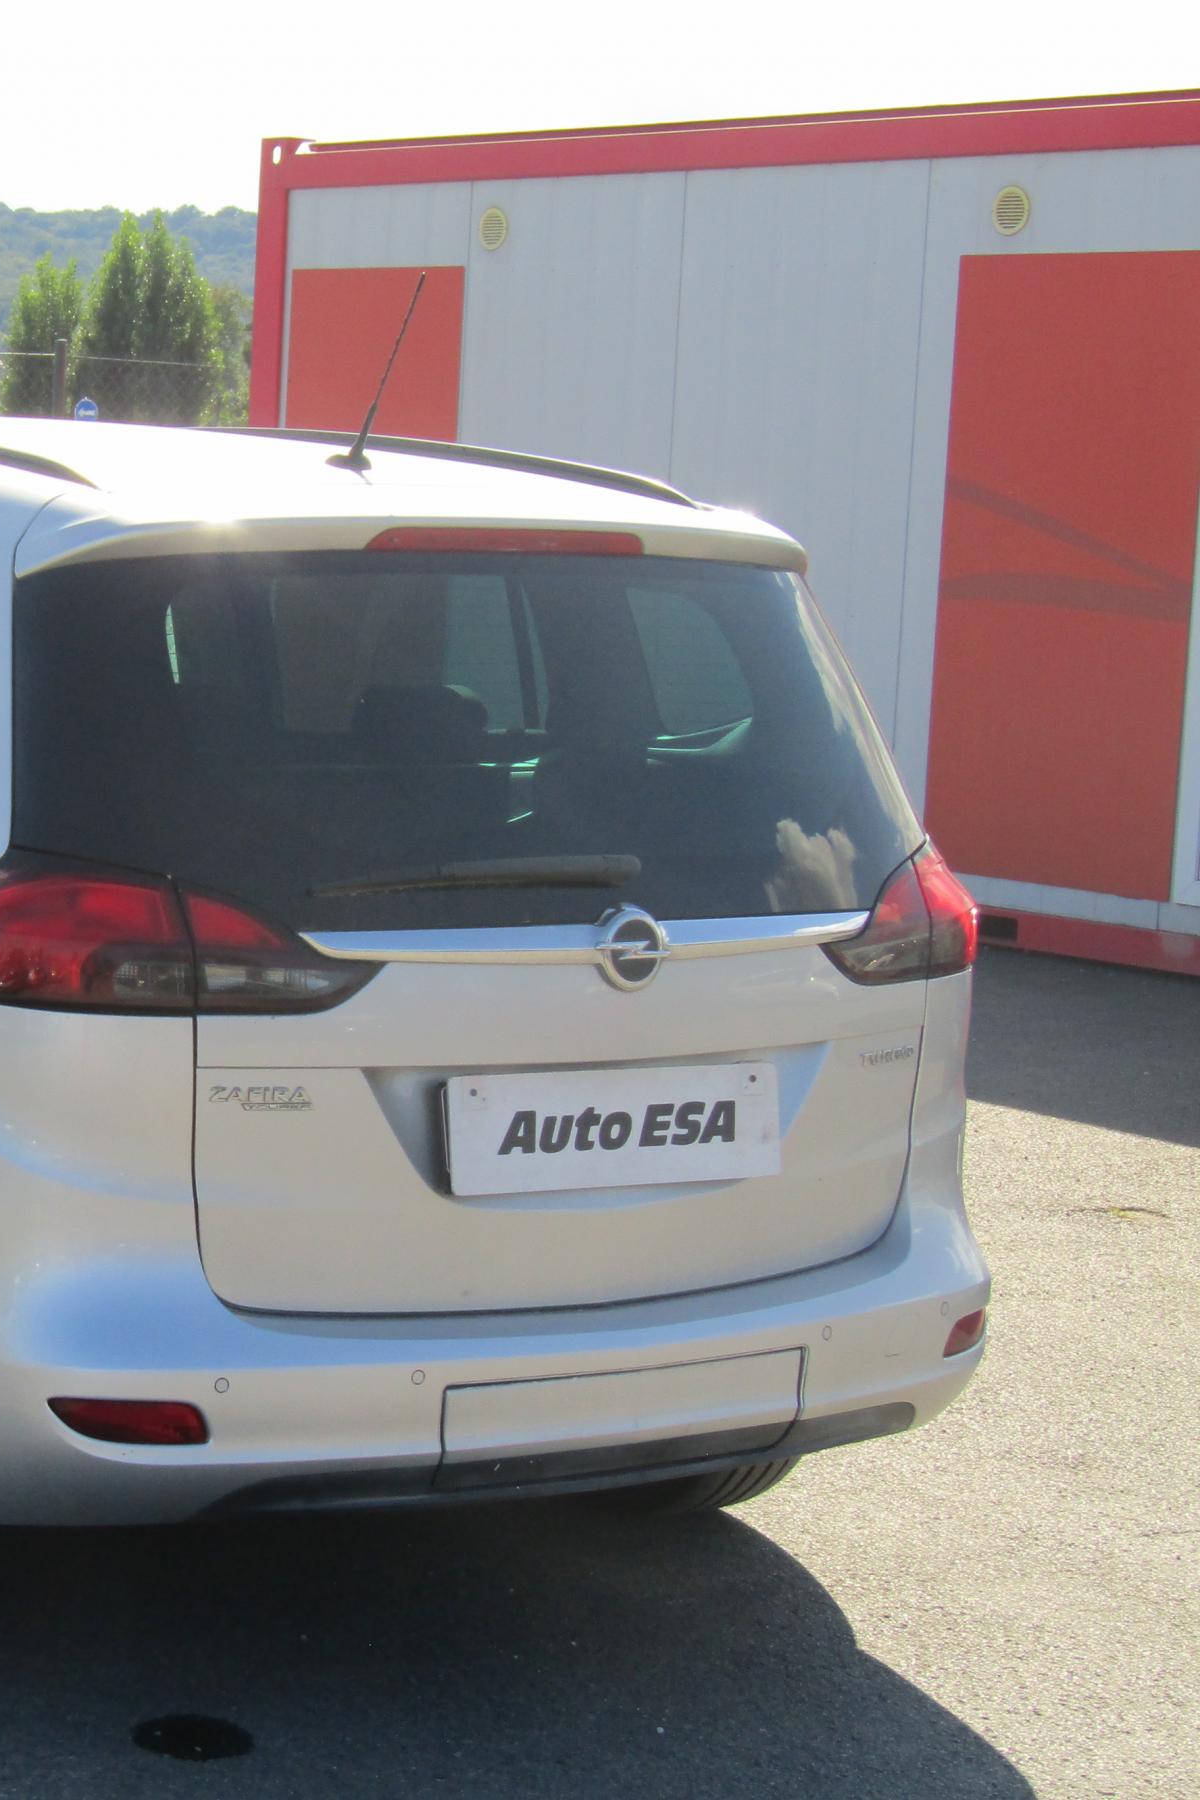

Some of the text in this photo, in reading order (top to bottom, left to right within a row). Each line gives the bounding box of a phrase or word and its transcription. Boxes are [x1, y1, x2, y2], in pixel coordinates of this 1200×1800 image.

[208, 1086, 312, 1102] ZAFIRA
[497, 1099, 736, 1156] Auto ESA
